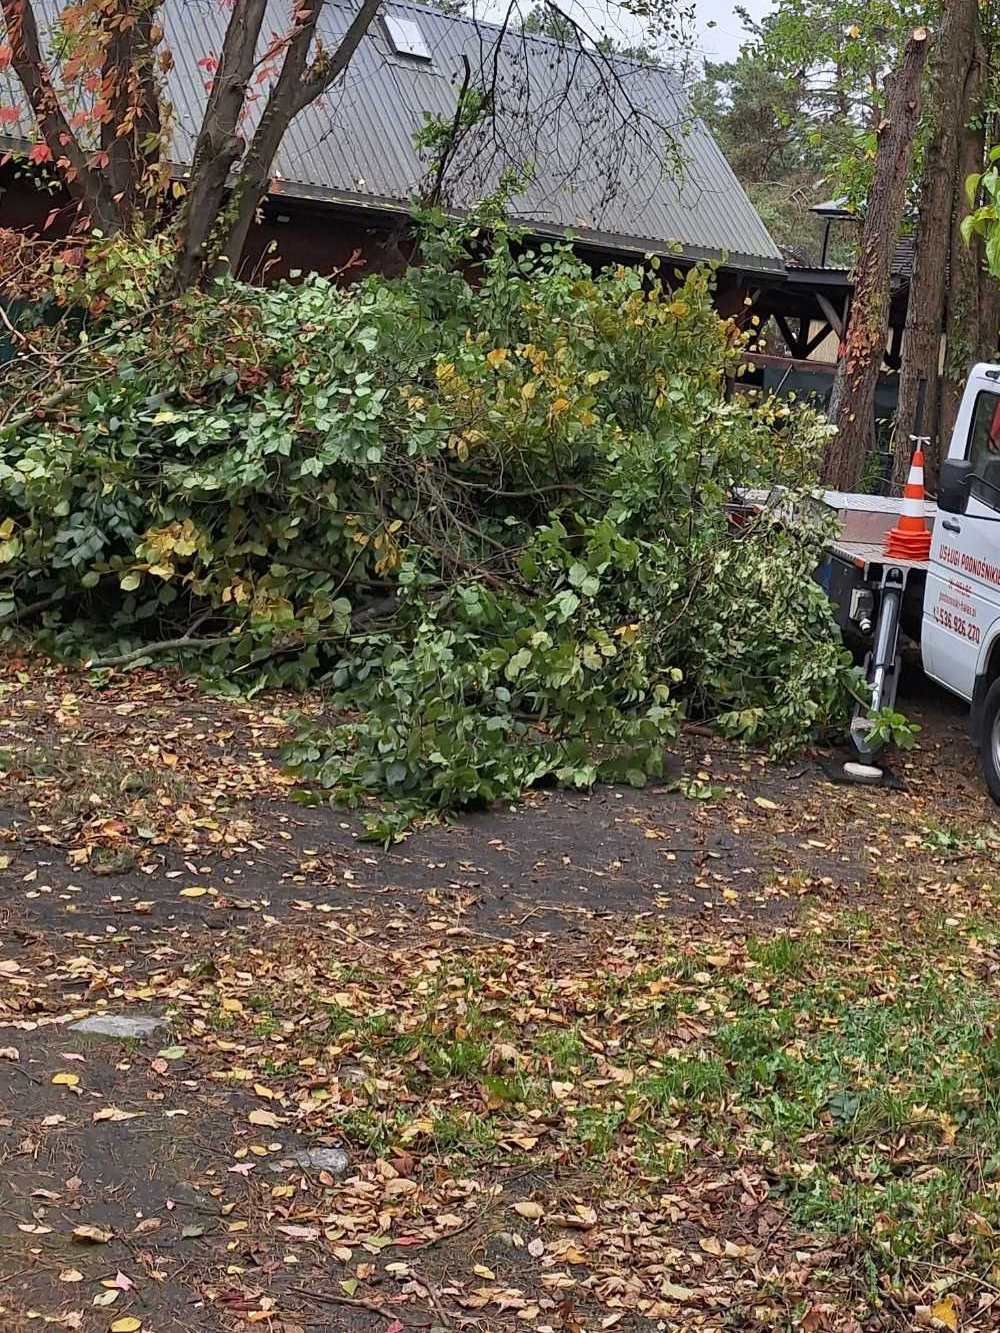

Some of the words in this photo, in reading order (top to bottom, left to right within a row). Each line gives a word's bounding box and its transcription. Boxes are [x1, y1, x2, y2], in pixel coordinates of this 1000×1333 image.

[939, 544, 960, 566] USŁUGI
[940, 608, 952, 629] 536
[953, 616, 966, 637] 926
[967, 623, 981, 645] 270
